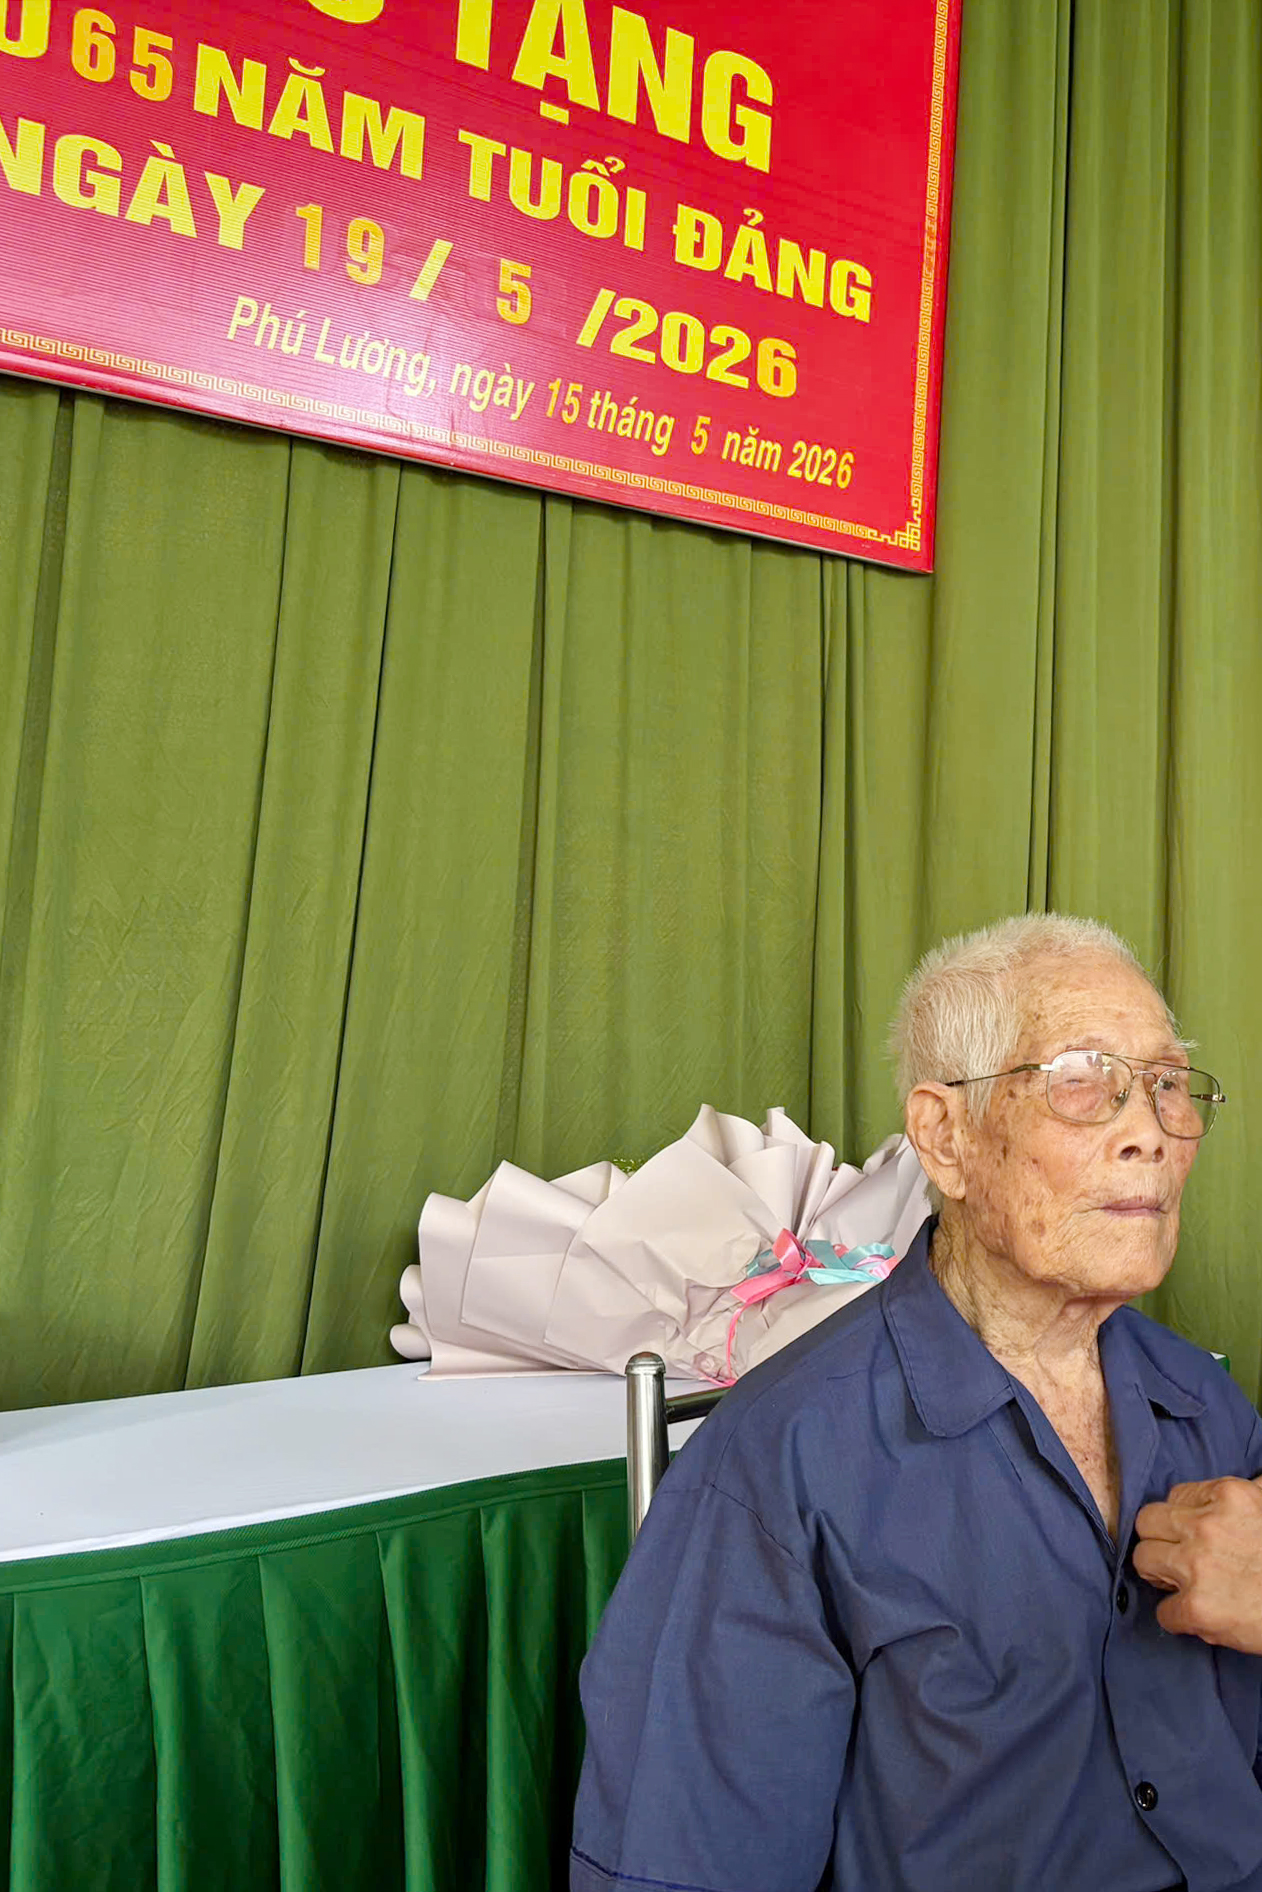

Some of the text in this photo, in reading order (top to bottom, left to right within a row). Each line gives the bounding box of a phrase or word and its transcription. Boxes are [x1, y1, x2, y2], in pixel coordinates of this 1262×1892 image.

[0, 115, 267, 250] NGÀY
[295, 203, 386, 286] 19
[495, 258, 533, 326] 5
[71, 8, 174, 102] 65
[194, 42, 426, 181] NĂM
[457, 129, 647, 252] TUỔI
[672, 203, 873, 323] ĐẢNG
[226, 295, 855, 490] Phú Lương, ngày 15 tháng 5 năm 2026
